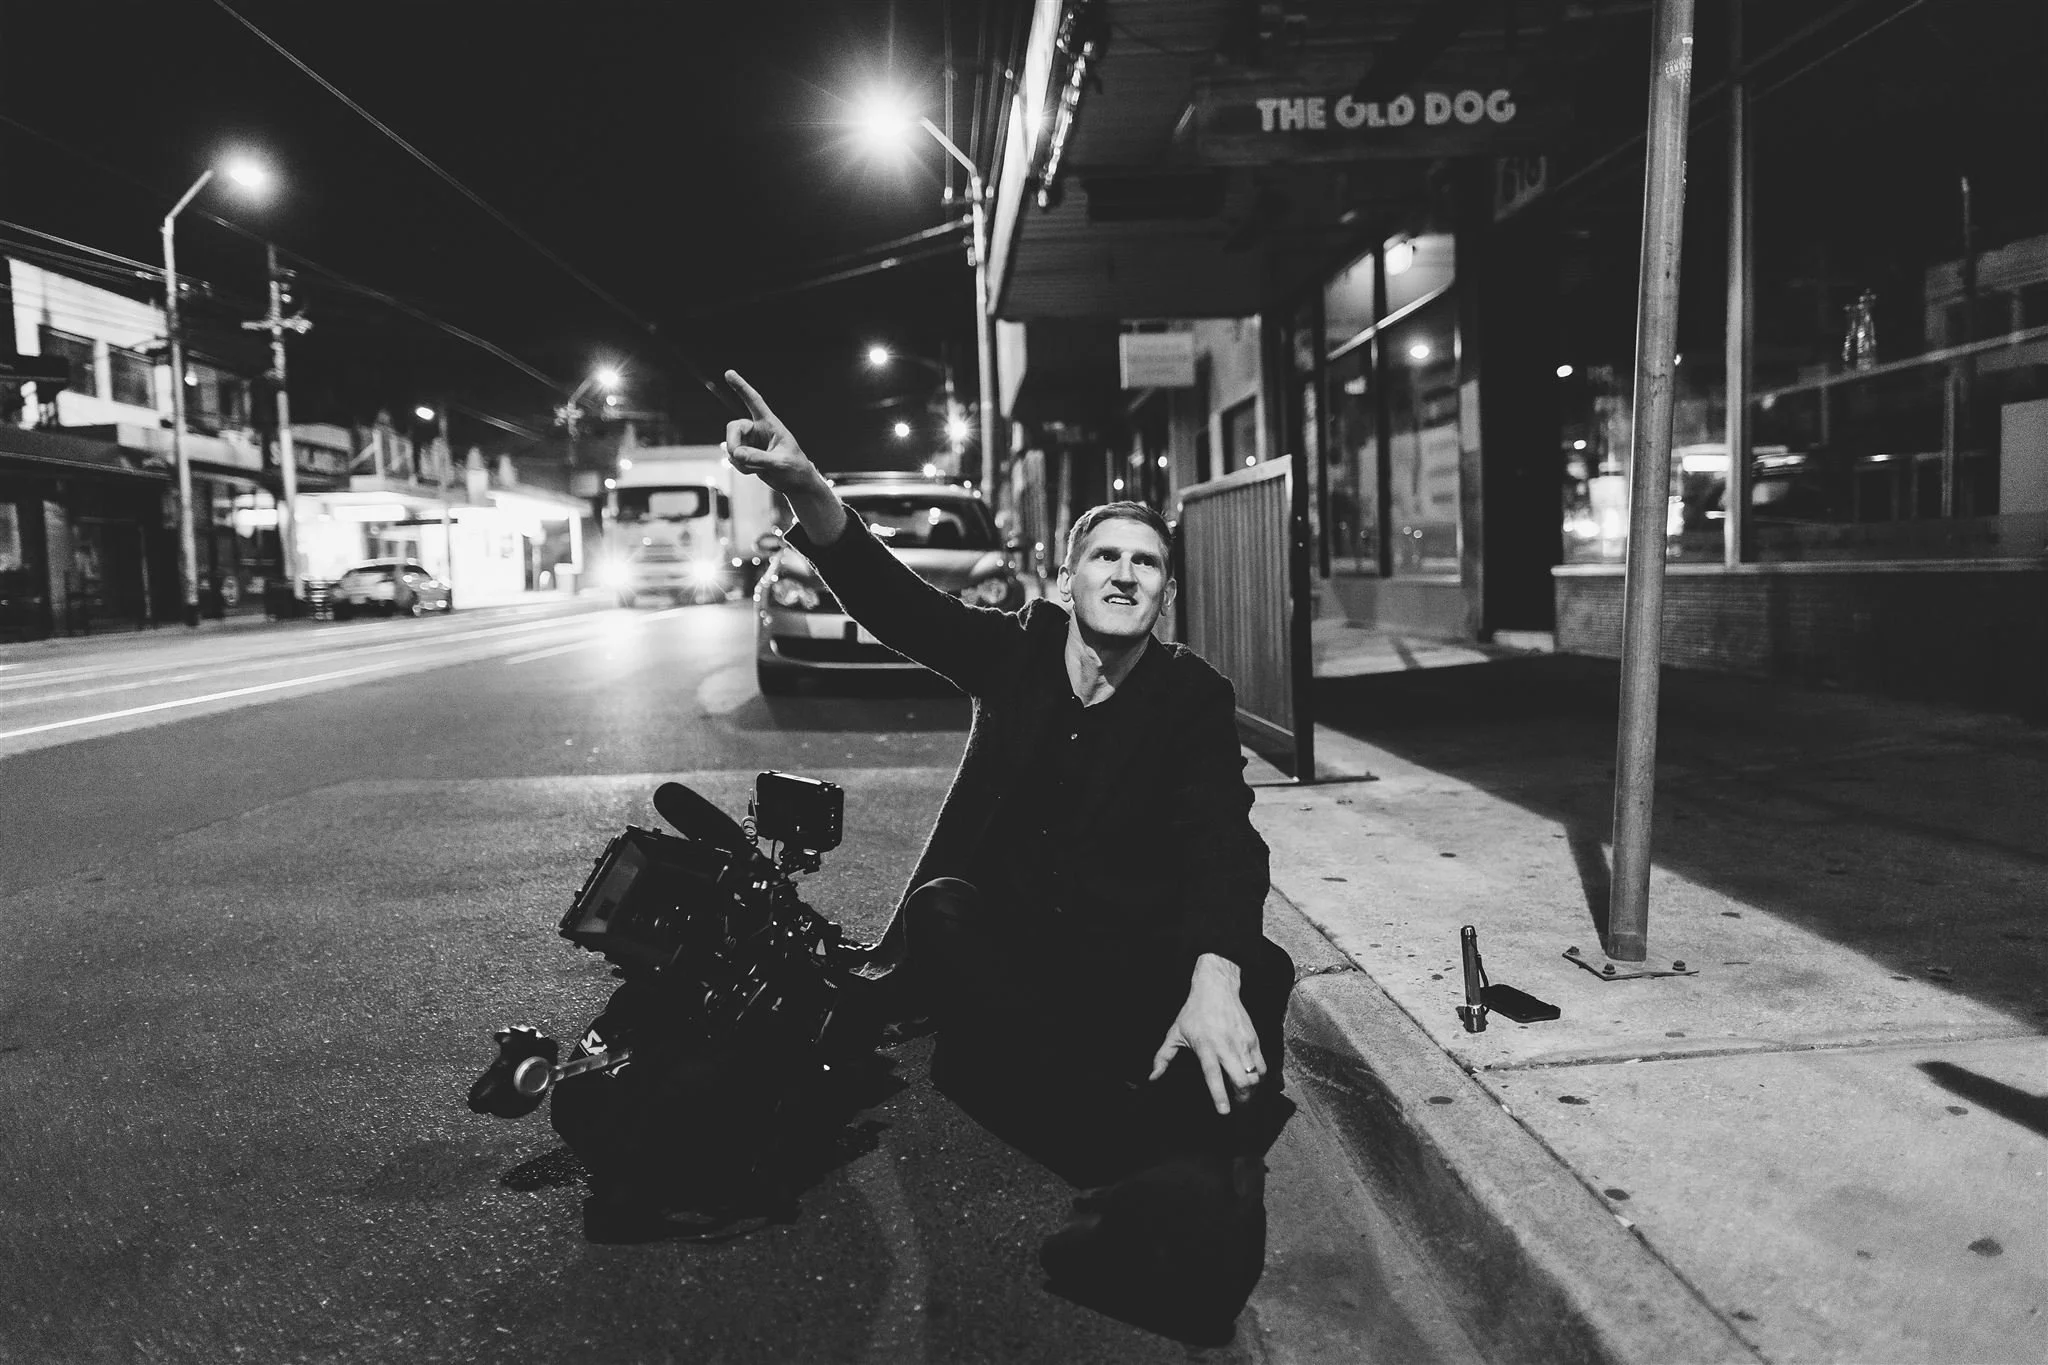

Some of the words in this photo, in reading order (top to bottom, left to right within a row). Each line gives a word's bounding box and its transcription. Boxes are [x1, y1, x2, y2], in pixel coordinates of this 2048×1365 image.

[1256, 96, 1326, 132] THE
[1334, 93, 1415, 129] OLD
[1424, 88, 1517, 125] DOG
